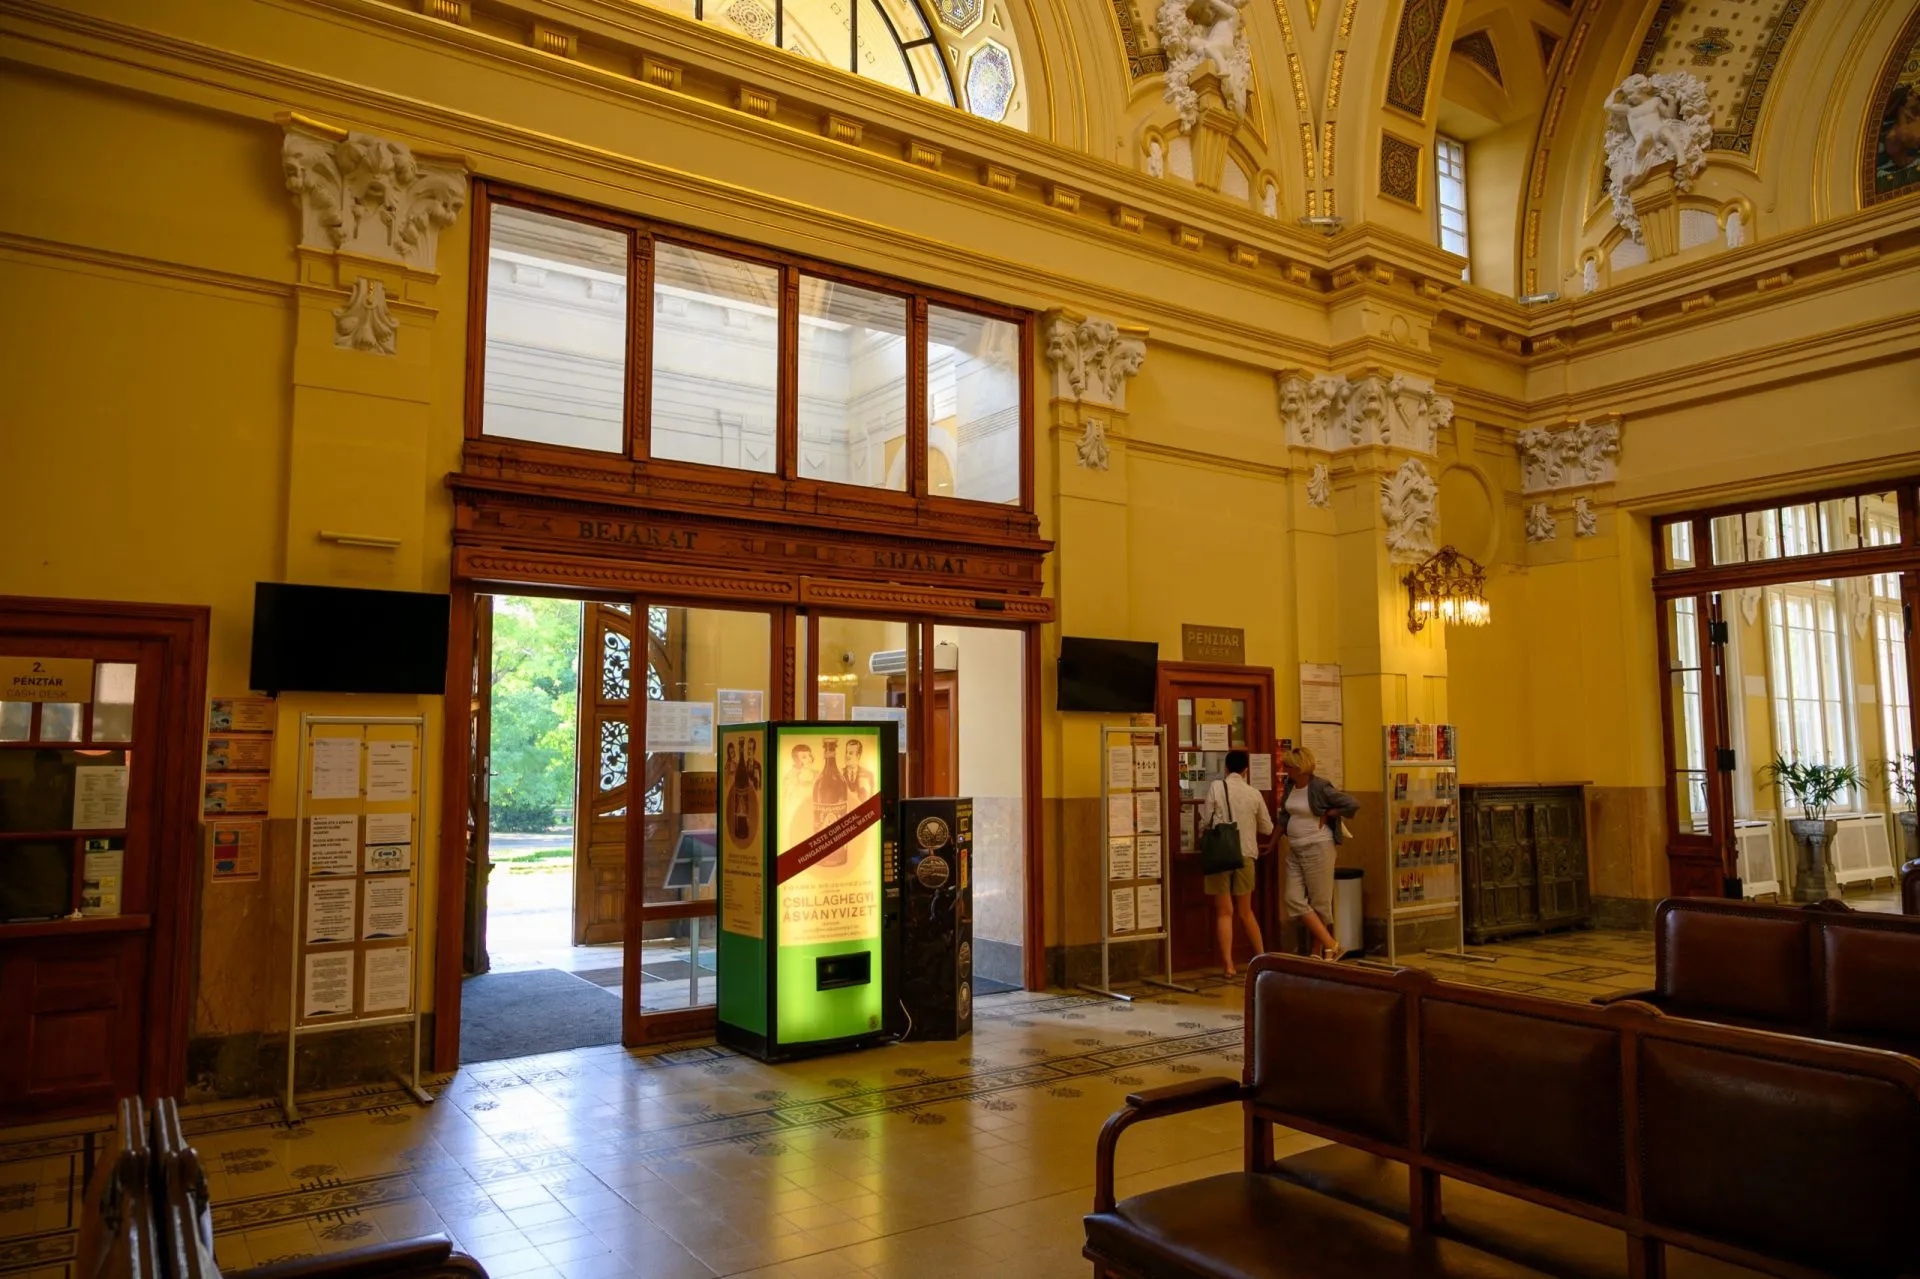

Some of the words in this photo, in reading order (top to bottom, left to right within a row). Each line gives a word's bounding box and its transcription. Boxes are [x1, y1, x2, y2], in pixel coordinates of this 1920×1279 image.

[33, 661, 46, 673] 2.
[13, 675, 64, 687] PÉNZTÁR
[798, 840, 833, 864] HUNGARIAN
[833, 824, 858, 842] MINERAL
[857, 811, 875, 826] WATER
[808, 834, 828, 848] TASTE
[829, 825, 841, 836] OUR
[841, 814, 860, 829] LOCAL
[783, 892, 874, 908] CSILLAGHEGYI
